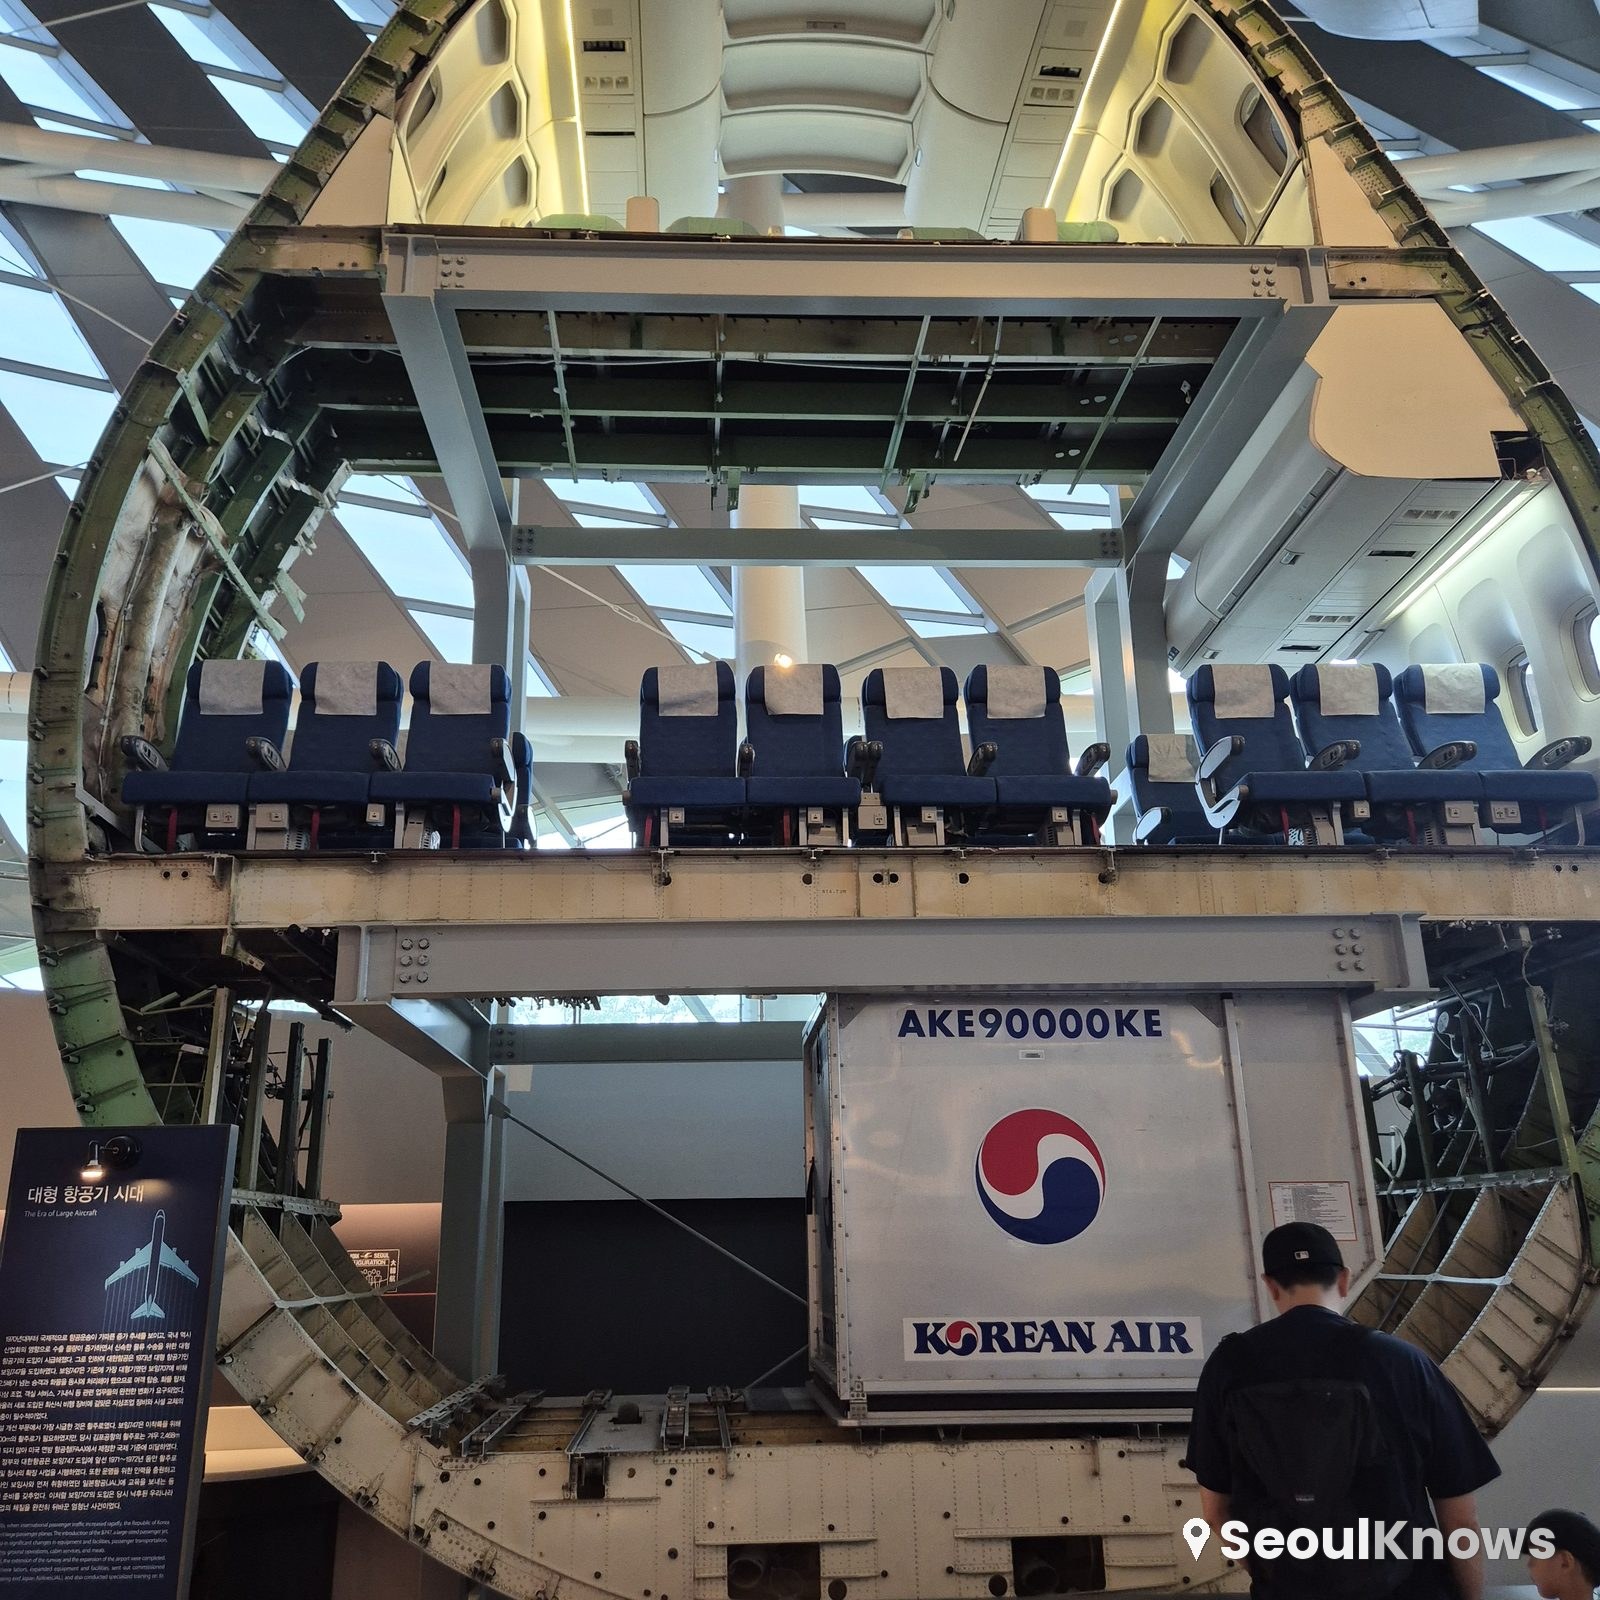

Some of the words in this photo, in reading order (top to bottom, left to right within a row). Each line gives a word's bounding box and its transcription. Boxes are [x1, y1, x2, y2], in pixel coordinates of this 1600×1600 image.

[898, 1008, 1162, 1039] AKE90000KE
[28, 1186, 58, 1204] 대형
[64, 1186, 109, 1204] 항공기
[114, 1184, 144, 1203] 시대
[912, 1320, 1097, 1356] KOREAN
[1104, 1320, 1194, 1354] AIR
